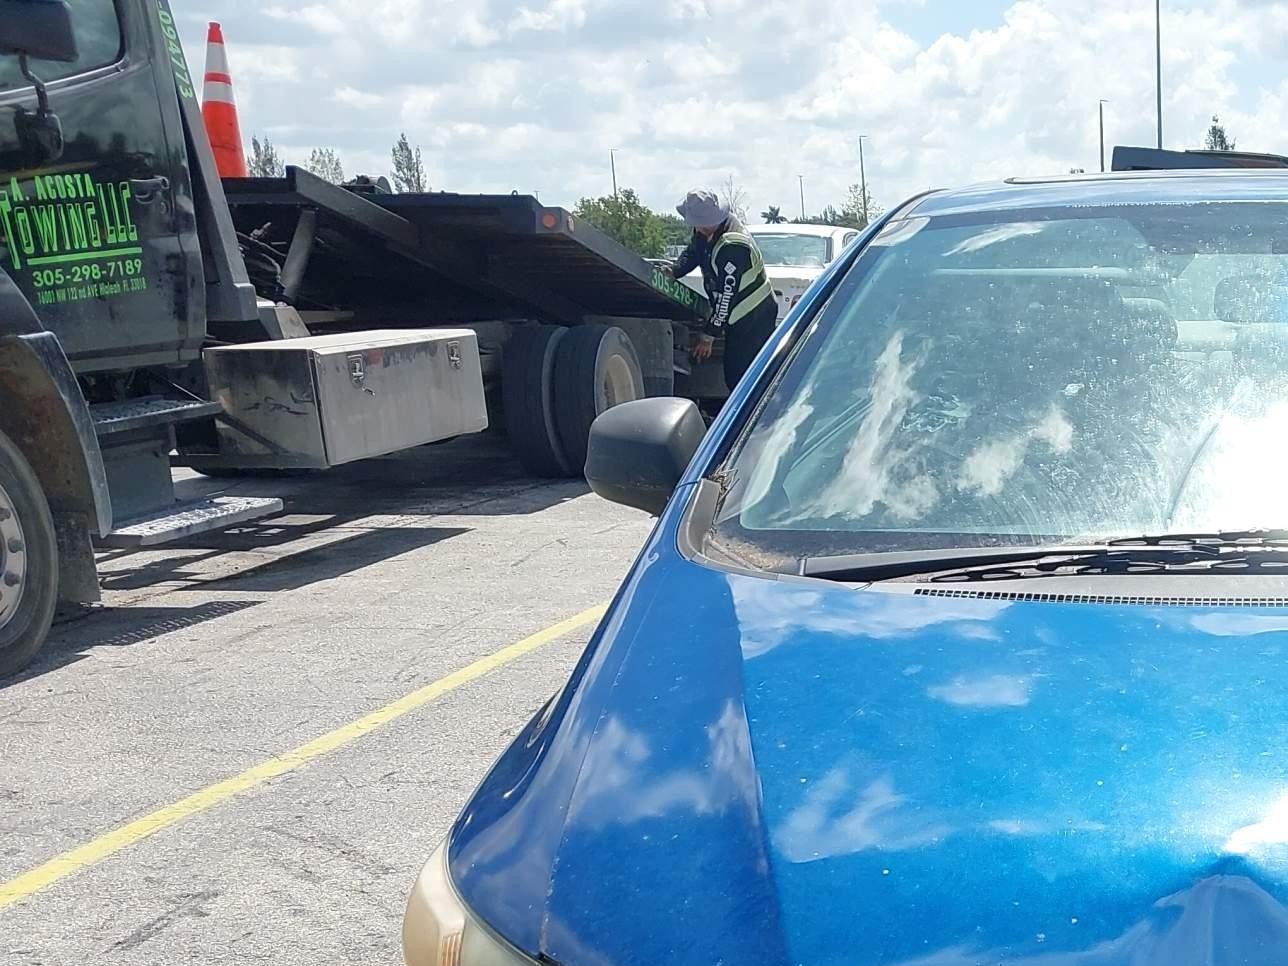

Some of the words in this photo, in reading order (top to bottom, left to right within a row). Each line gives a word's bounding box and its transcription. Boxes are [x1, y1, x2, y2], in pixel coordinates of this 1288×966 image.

[11, 176, 30, 201] A.
[34, 173, 96, 200] ACOSTA
[96, 182, 138, 243] LLC
[32, 258, 142, 287] 305-298-7189
[87, 284, 98, 298] AVE
[714, 275, 736, 326] Columbia
